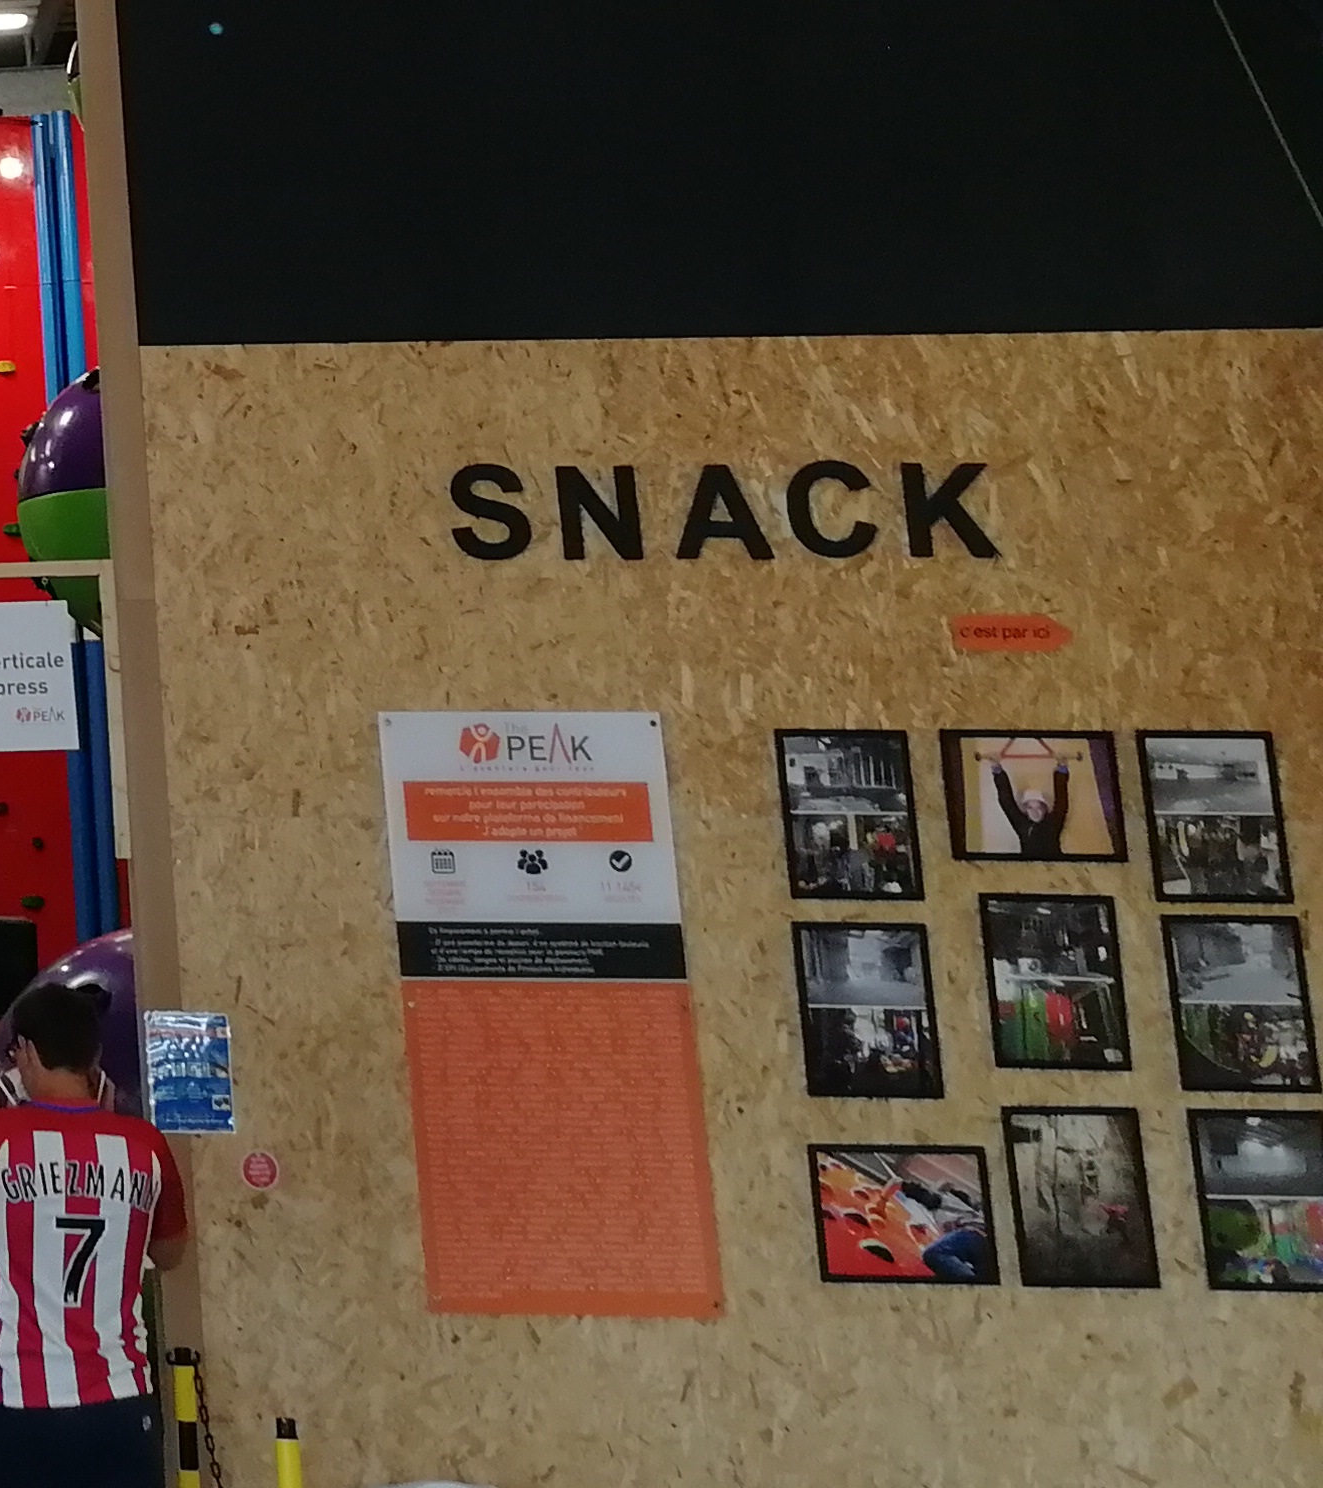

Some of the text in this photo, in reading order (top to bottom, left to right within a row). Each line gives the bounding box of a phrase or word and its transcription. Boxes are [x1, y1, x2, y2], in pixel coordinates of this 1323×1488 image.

[449, 460, 1001, 561] SNACK
[1002, 626, 1028, 641] par
[1032, 624, 1051, 639] ici
[33, 706, 66, 723] PEAK
[506, 722, 593, 765] PEAK
[0, 1161, 158, 1212] GRIEZMANN
[53, 1214, 108, 1308] 7
